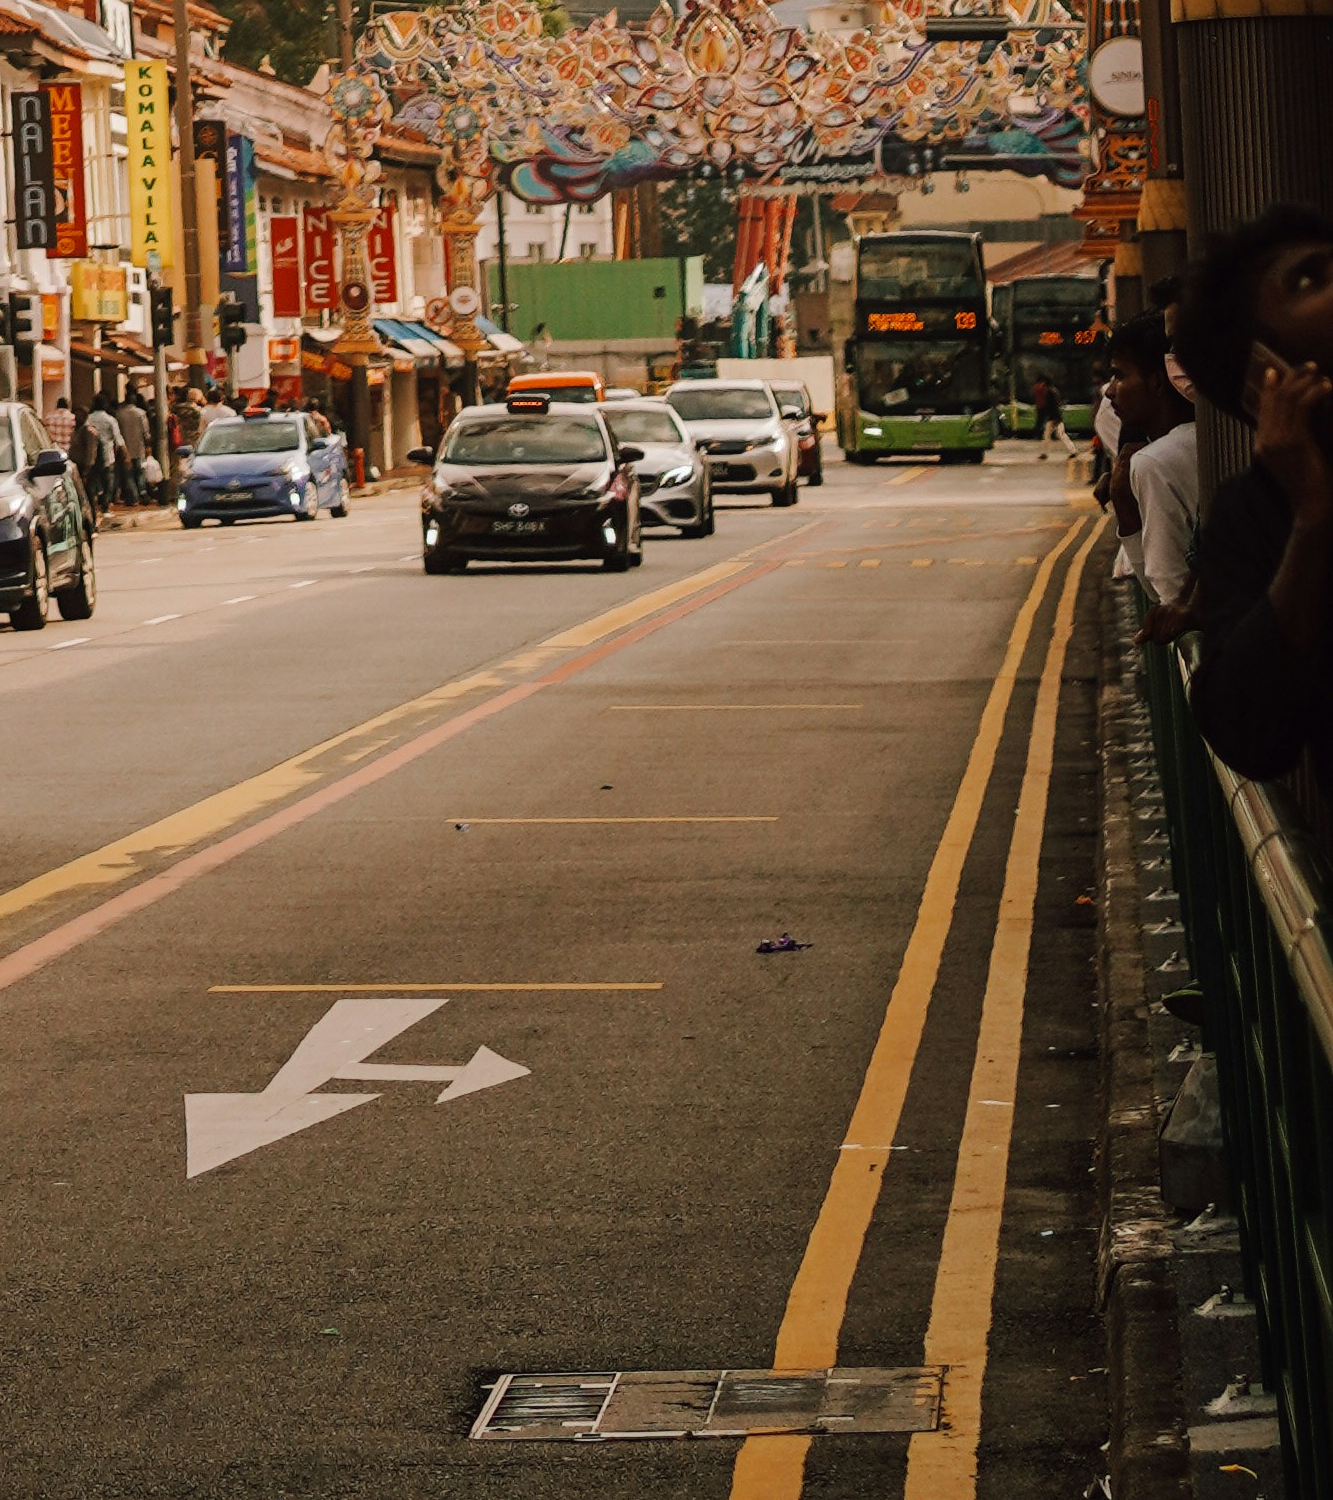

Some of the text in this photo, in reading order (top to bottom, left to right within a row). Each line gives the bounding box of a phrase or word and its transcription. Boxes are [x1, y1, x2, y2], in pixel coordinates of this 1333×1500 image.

[138, 66, 159, 252] KOMALA VILA
[306, 213, 331, 303] NICE
